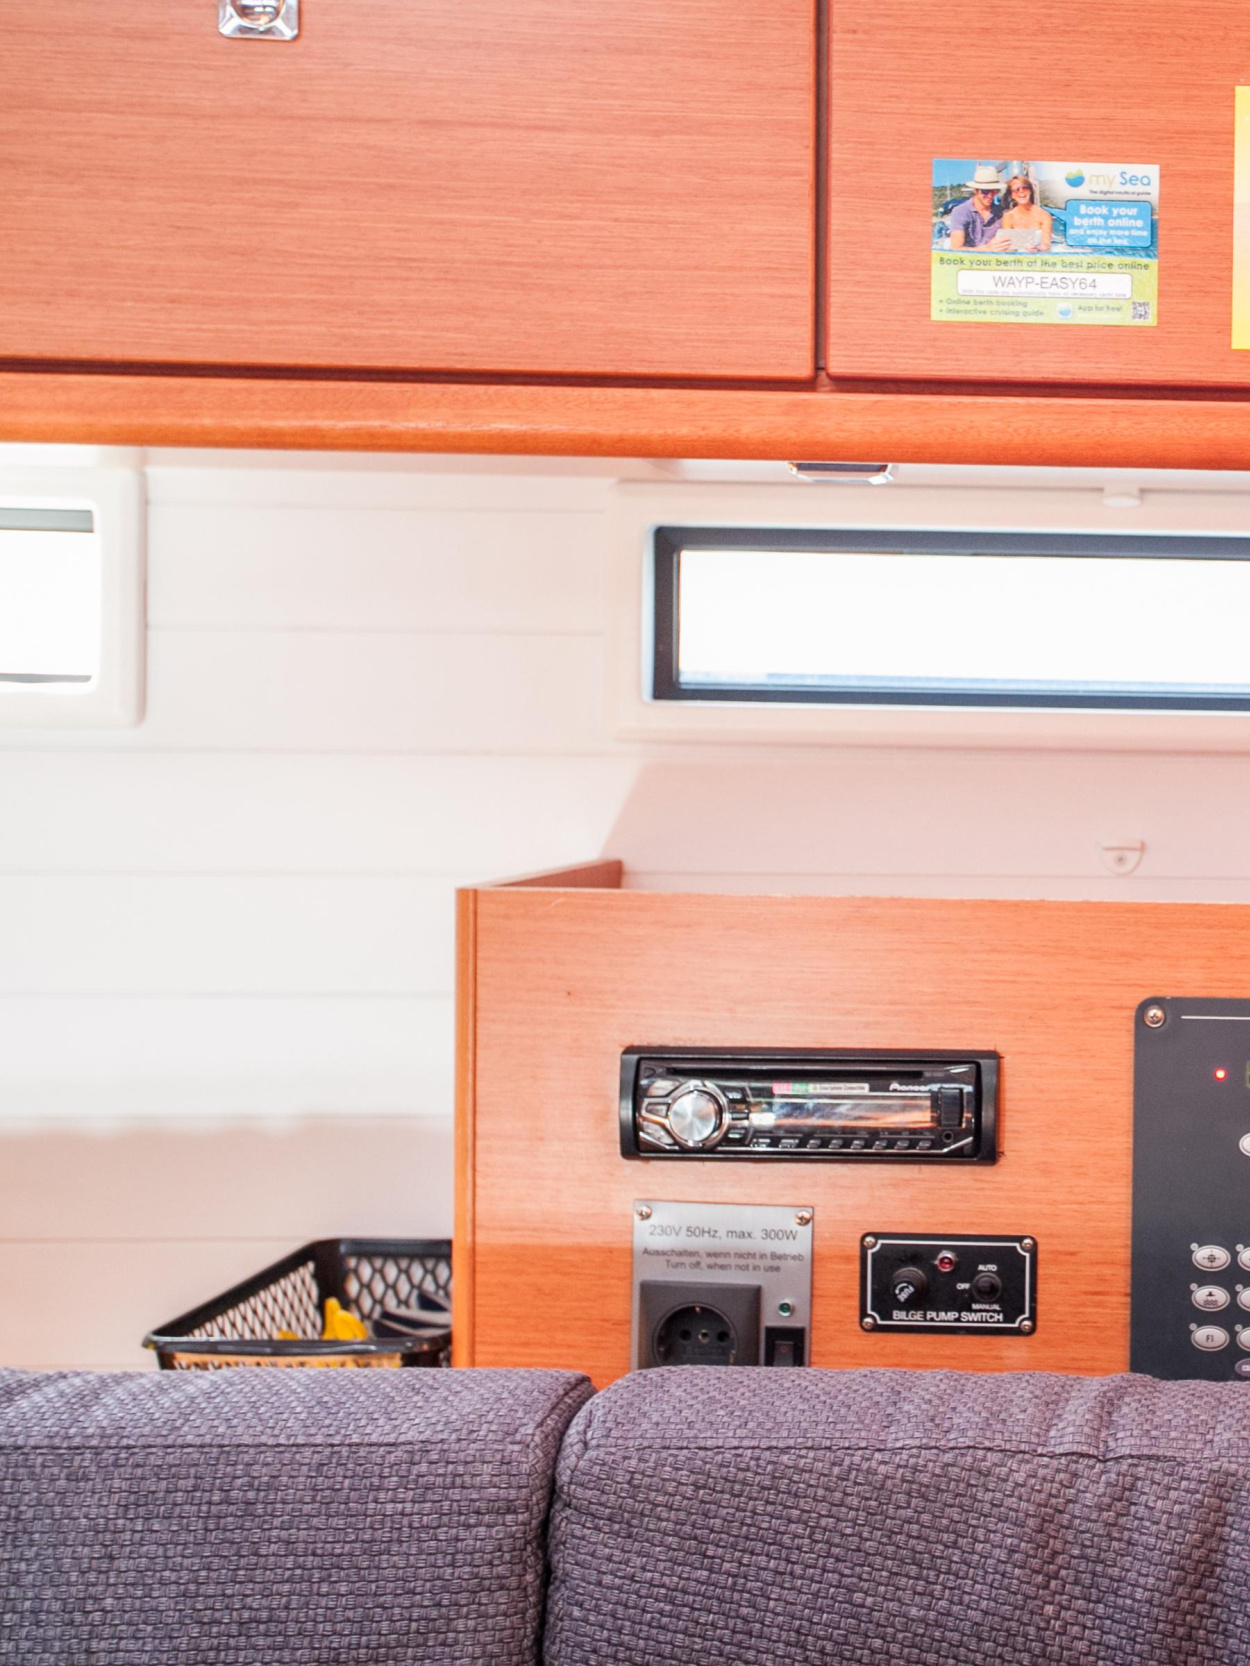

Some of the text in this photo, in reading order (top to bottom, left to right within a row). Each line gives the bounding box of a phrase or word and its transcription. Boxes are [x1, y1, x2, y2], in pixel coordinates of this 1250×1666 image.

[1089, 171, 1151, 189] my Sea
[1079, 204, 1138, 217] Book your
[1074, 216, 1144, 227] berth online
[939, 257, 965, 265] Book
[969, 259, 991, 267] your
[996, 258, 1023, 267] berth
[1027, 259, 1037, 267] at
[1087, 261, 1113, 270] price
[1118, 262, 1149, 270] online
[992, 275, 1097, 290] WAYP-EASY64
[996, 299, 1028, 308] booking
[649, 1224, 798, 1241] 230V 50Hz, max. 300W
[642, 1247, 804, 1262] Ausschalten, wenn nicht in Betrieb
[665, 1259, 686, 1269] Turn
[706, 1261, 732, 1271] when
[735, 1262, 751, 1272] not
[752, 1262, 761, 1272] in
[763, 1264, 781, 1273] use
[977, 1264, 997, 1272] AUTO
[897, 1285, 915, 1303] FUSE
[972, 1303, 1001, 1311] MANUAL
[892, 1310, 1003, 1322] BILGE PUMP SWITCH
[1206, 1334, 1215, 1343] F1
